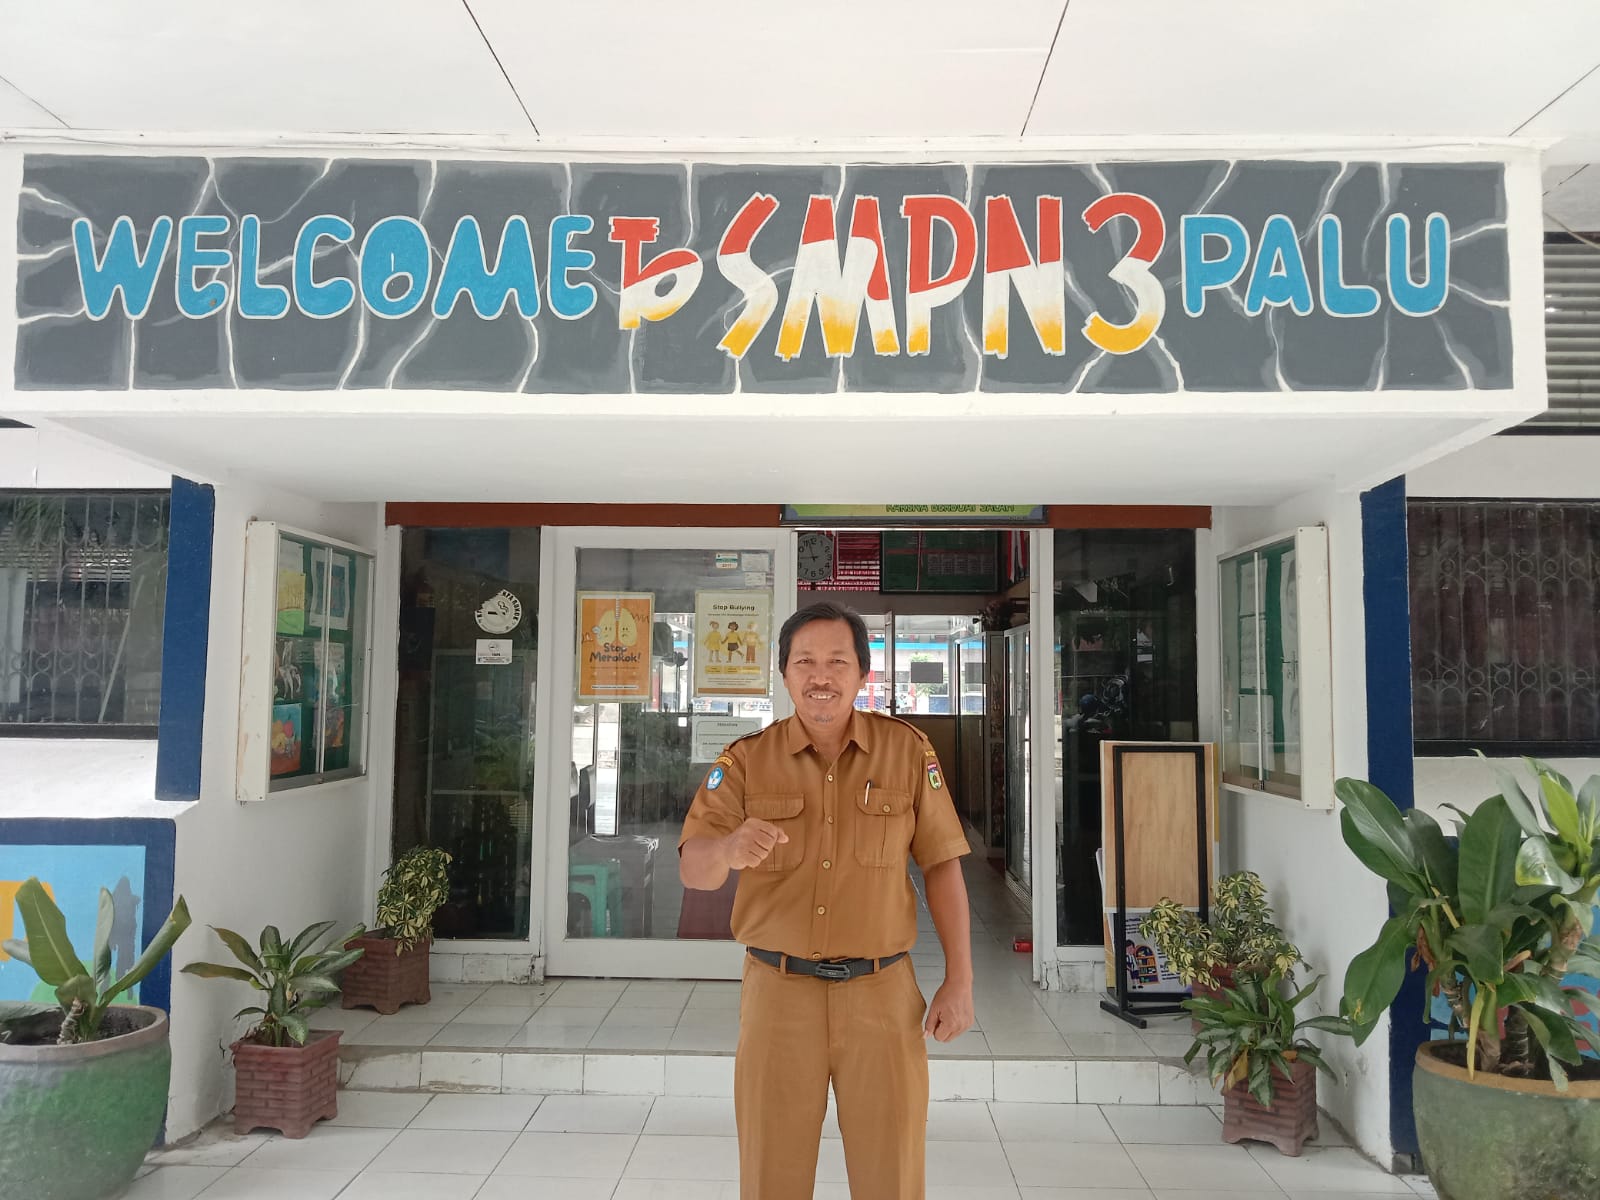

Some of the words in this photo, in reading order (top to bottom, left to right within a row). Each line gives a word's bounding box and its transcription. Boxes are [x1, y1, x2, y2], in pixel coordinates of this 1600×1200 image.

[72, 213, 597, 321] WELCOME
[716, 191, 1066, 361] SMPN
[1081, 191, 1167, 356] 3
[1180, 211, 1451, 319] PALU
[729, 604, 756, 612] Bullying
[603, 642, 628, 656] Stop
[589, 651, 642, 663] Merokok!
